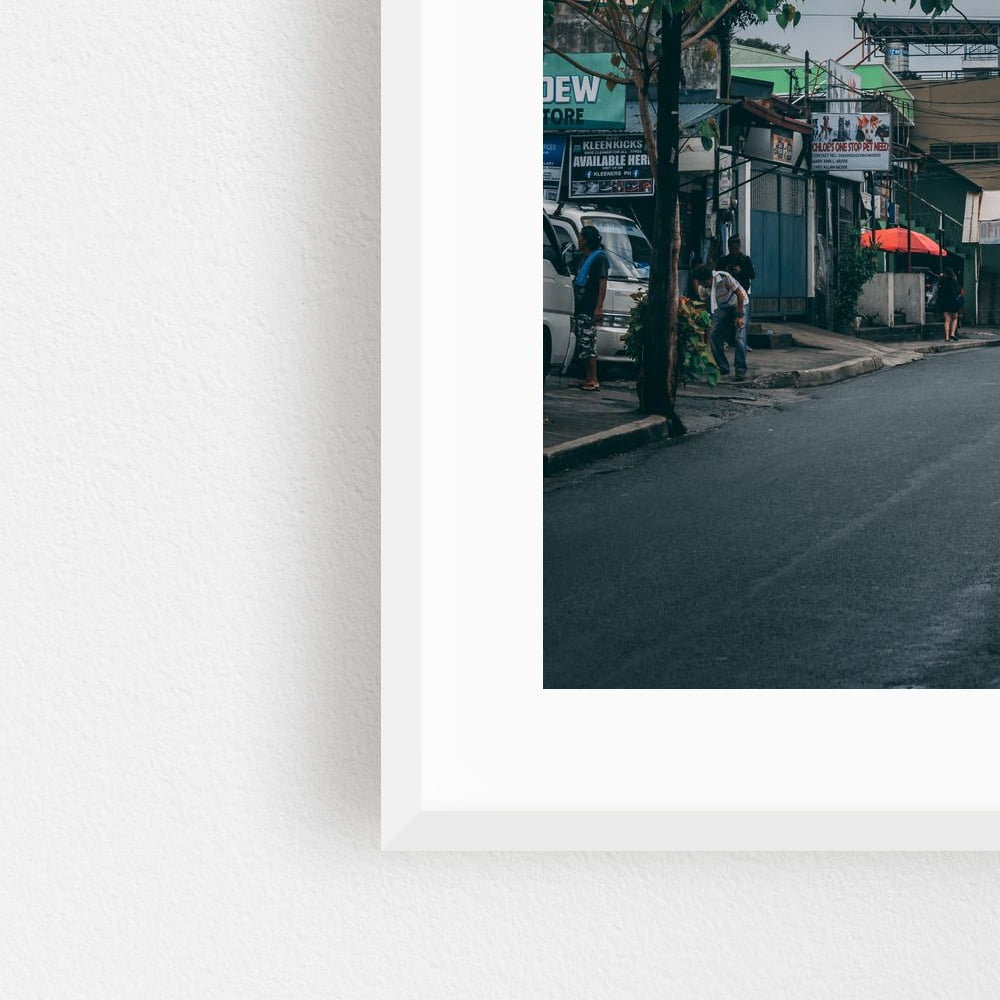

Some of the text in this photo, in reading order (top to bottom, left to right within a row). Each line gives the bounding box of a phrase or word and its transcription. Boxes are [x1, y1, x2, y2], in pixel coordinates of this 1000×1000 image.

[835, 143, 847, 152] ONE
[848, 143, 861, 152] STOP
[863, 142, 873, 152] PET
[573, 155, 626, 168] AVAILABLE
